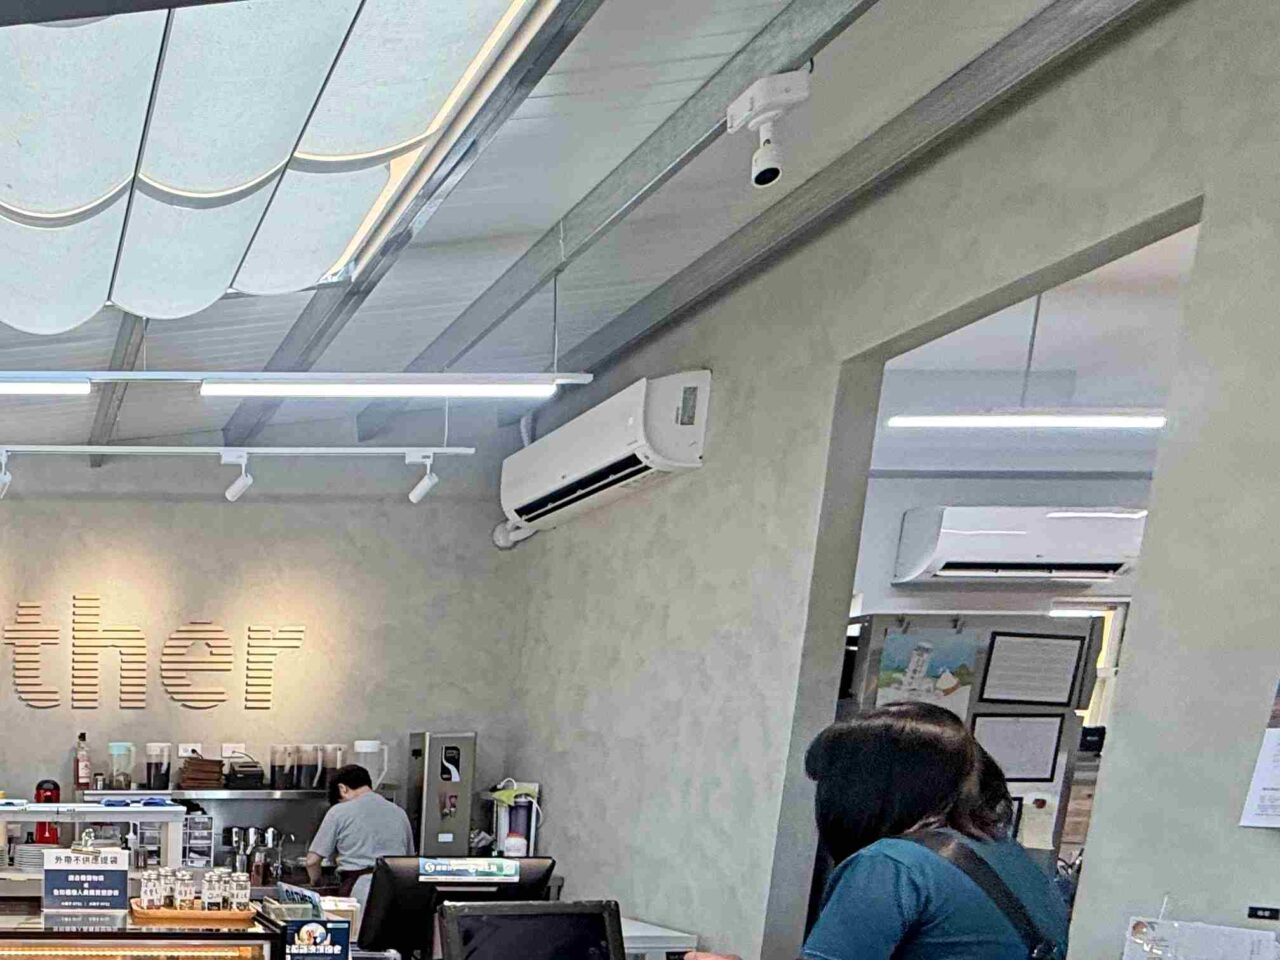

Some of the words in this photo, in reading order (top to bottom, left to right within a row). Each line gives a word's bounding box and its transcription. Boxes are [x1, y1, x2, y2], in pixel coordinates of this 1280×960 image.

[54, 855, 118, 865] 外帶不供應提袋
